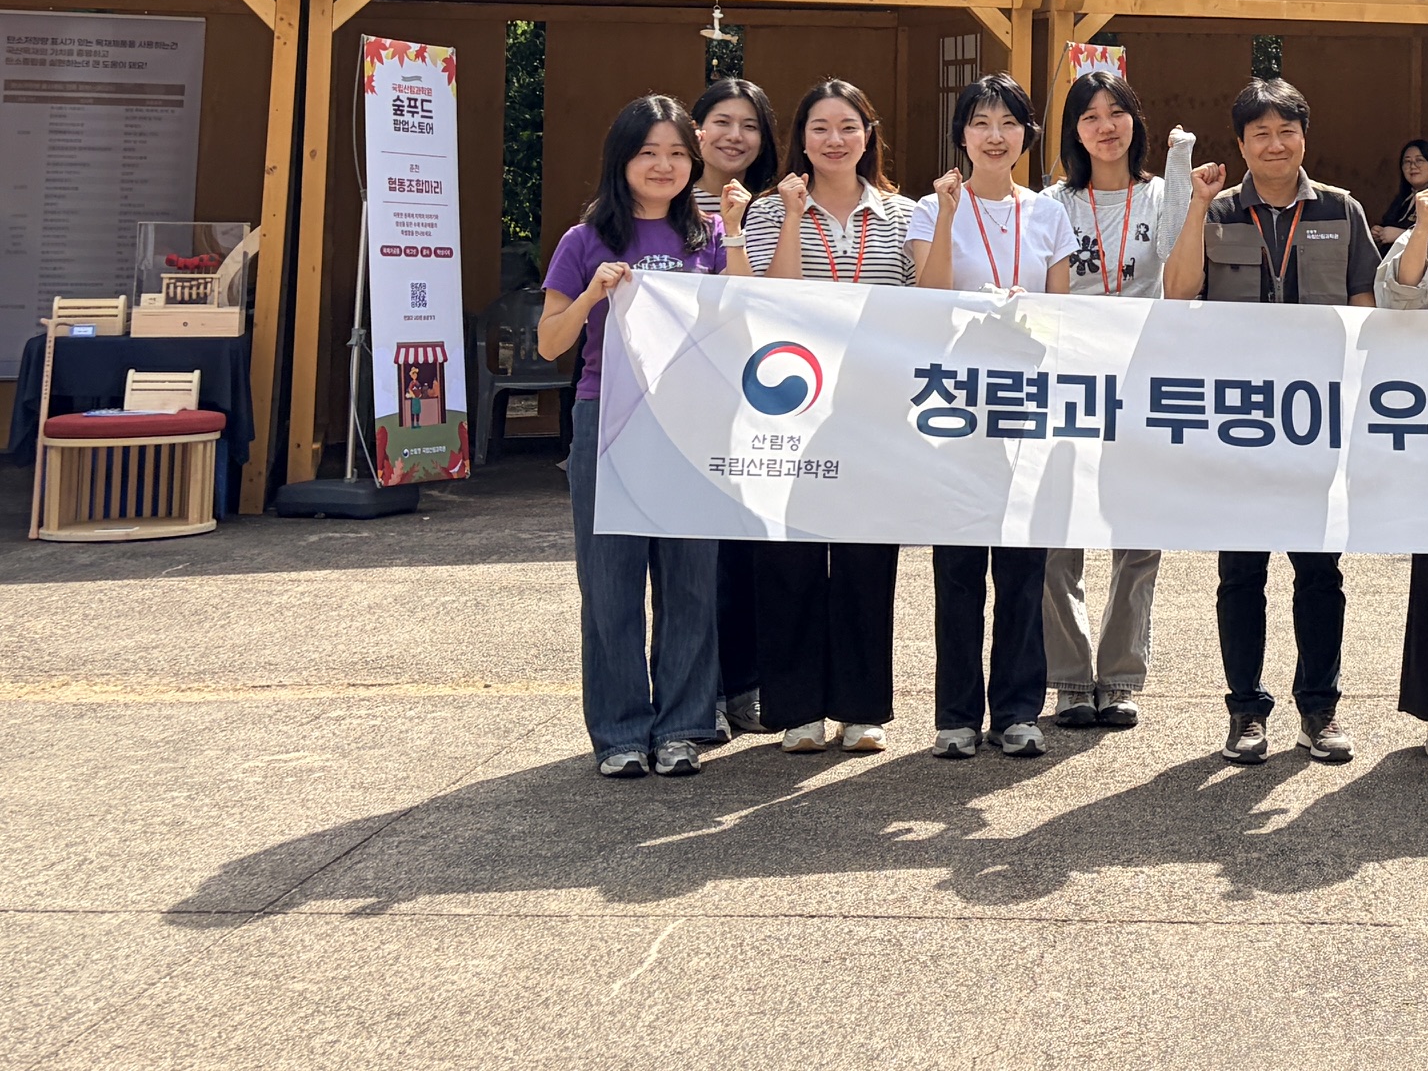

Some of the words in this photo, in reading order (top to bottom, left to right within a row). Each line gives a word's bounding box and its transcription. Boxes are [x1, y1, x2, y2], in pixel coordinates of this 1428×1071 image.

[392, 95, 434, 119] 숲푸드
[393, 119, 434, 135] 팝업스토어
[387, 177, 442, 195] 협동조합마리
[909, 363, 1123, 442] 청렴과
[1146, 376, 1342, 448] 투명이
[751, 433, 801, 451] 산림청
[708, 457, 840, 479] 국립산림과학원
